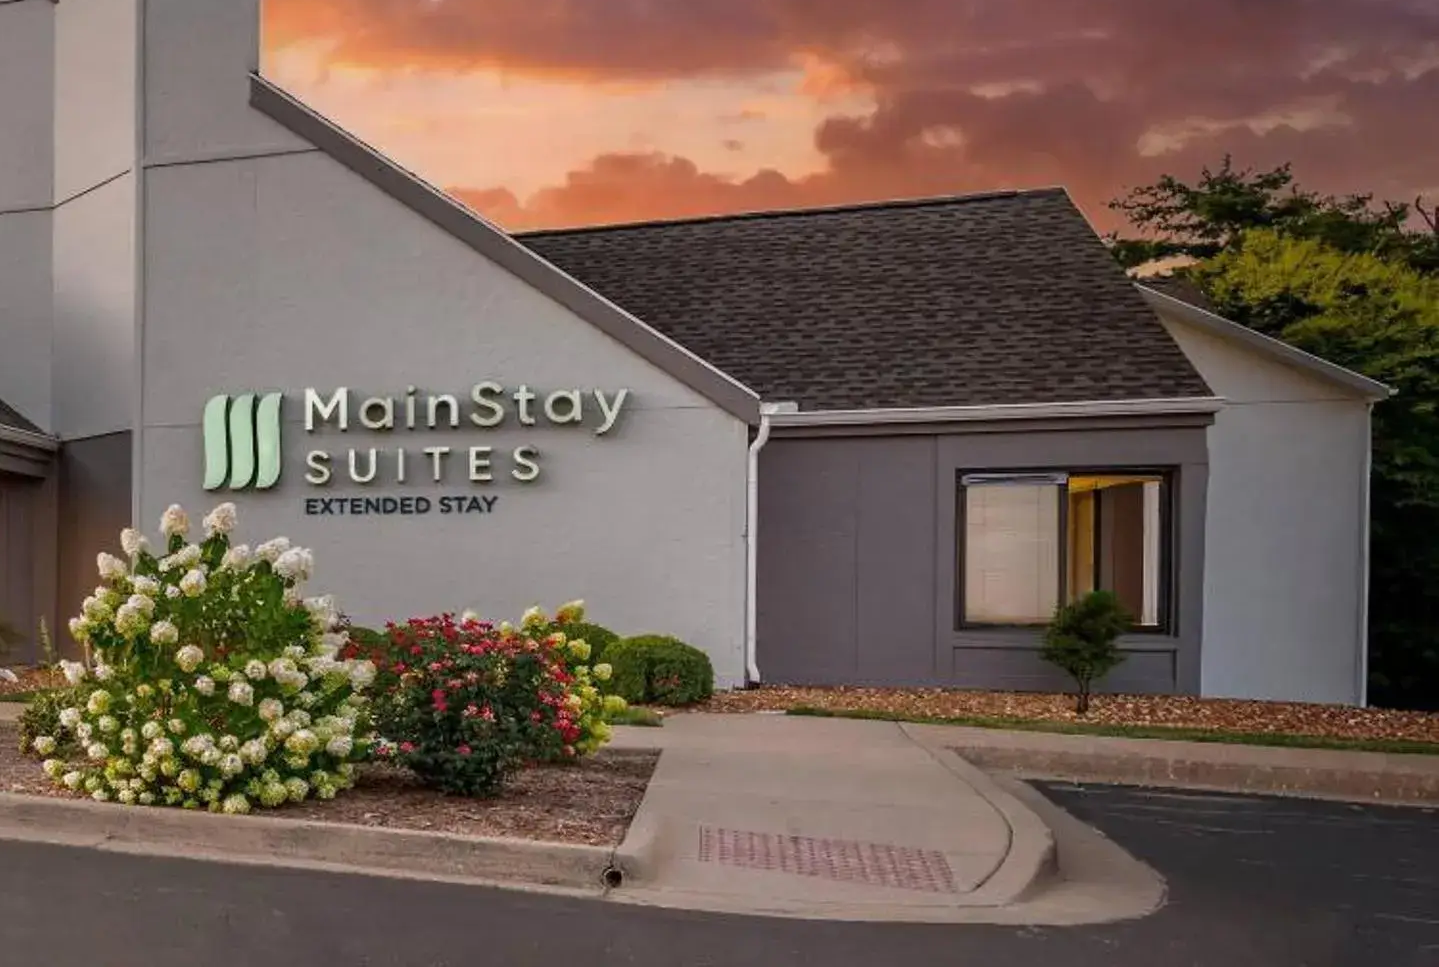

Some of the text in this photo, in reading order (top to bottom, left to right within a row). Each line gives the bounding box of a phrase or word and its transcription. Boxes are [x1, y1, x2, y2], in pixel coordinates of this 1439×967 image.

[304, 381, 628, 434] MainStay
[305, 446, 541, 484] SUITES
[305, 495, 498, 515] EXTENDED STAY
